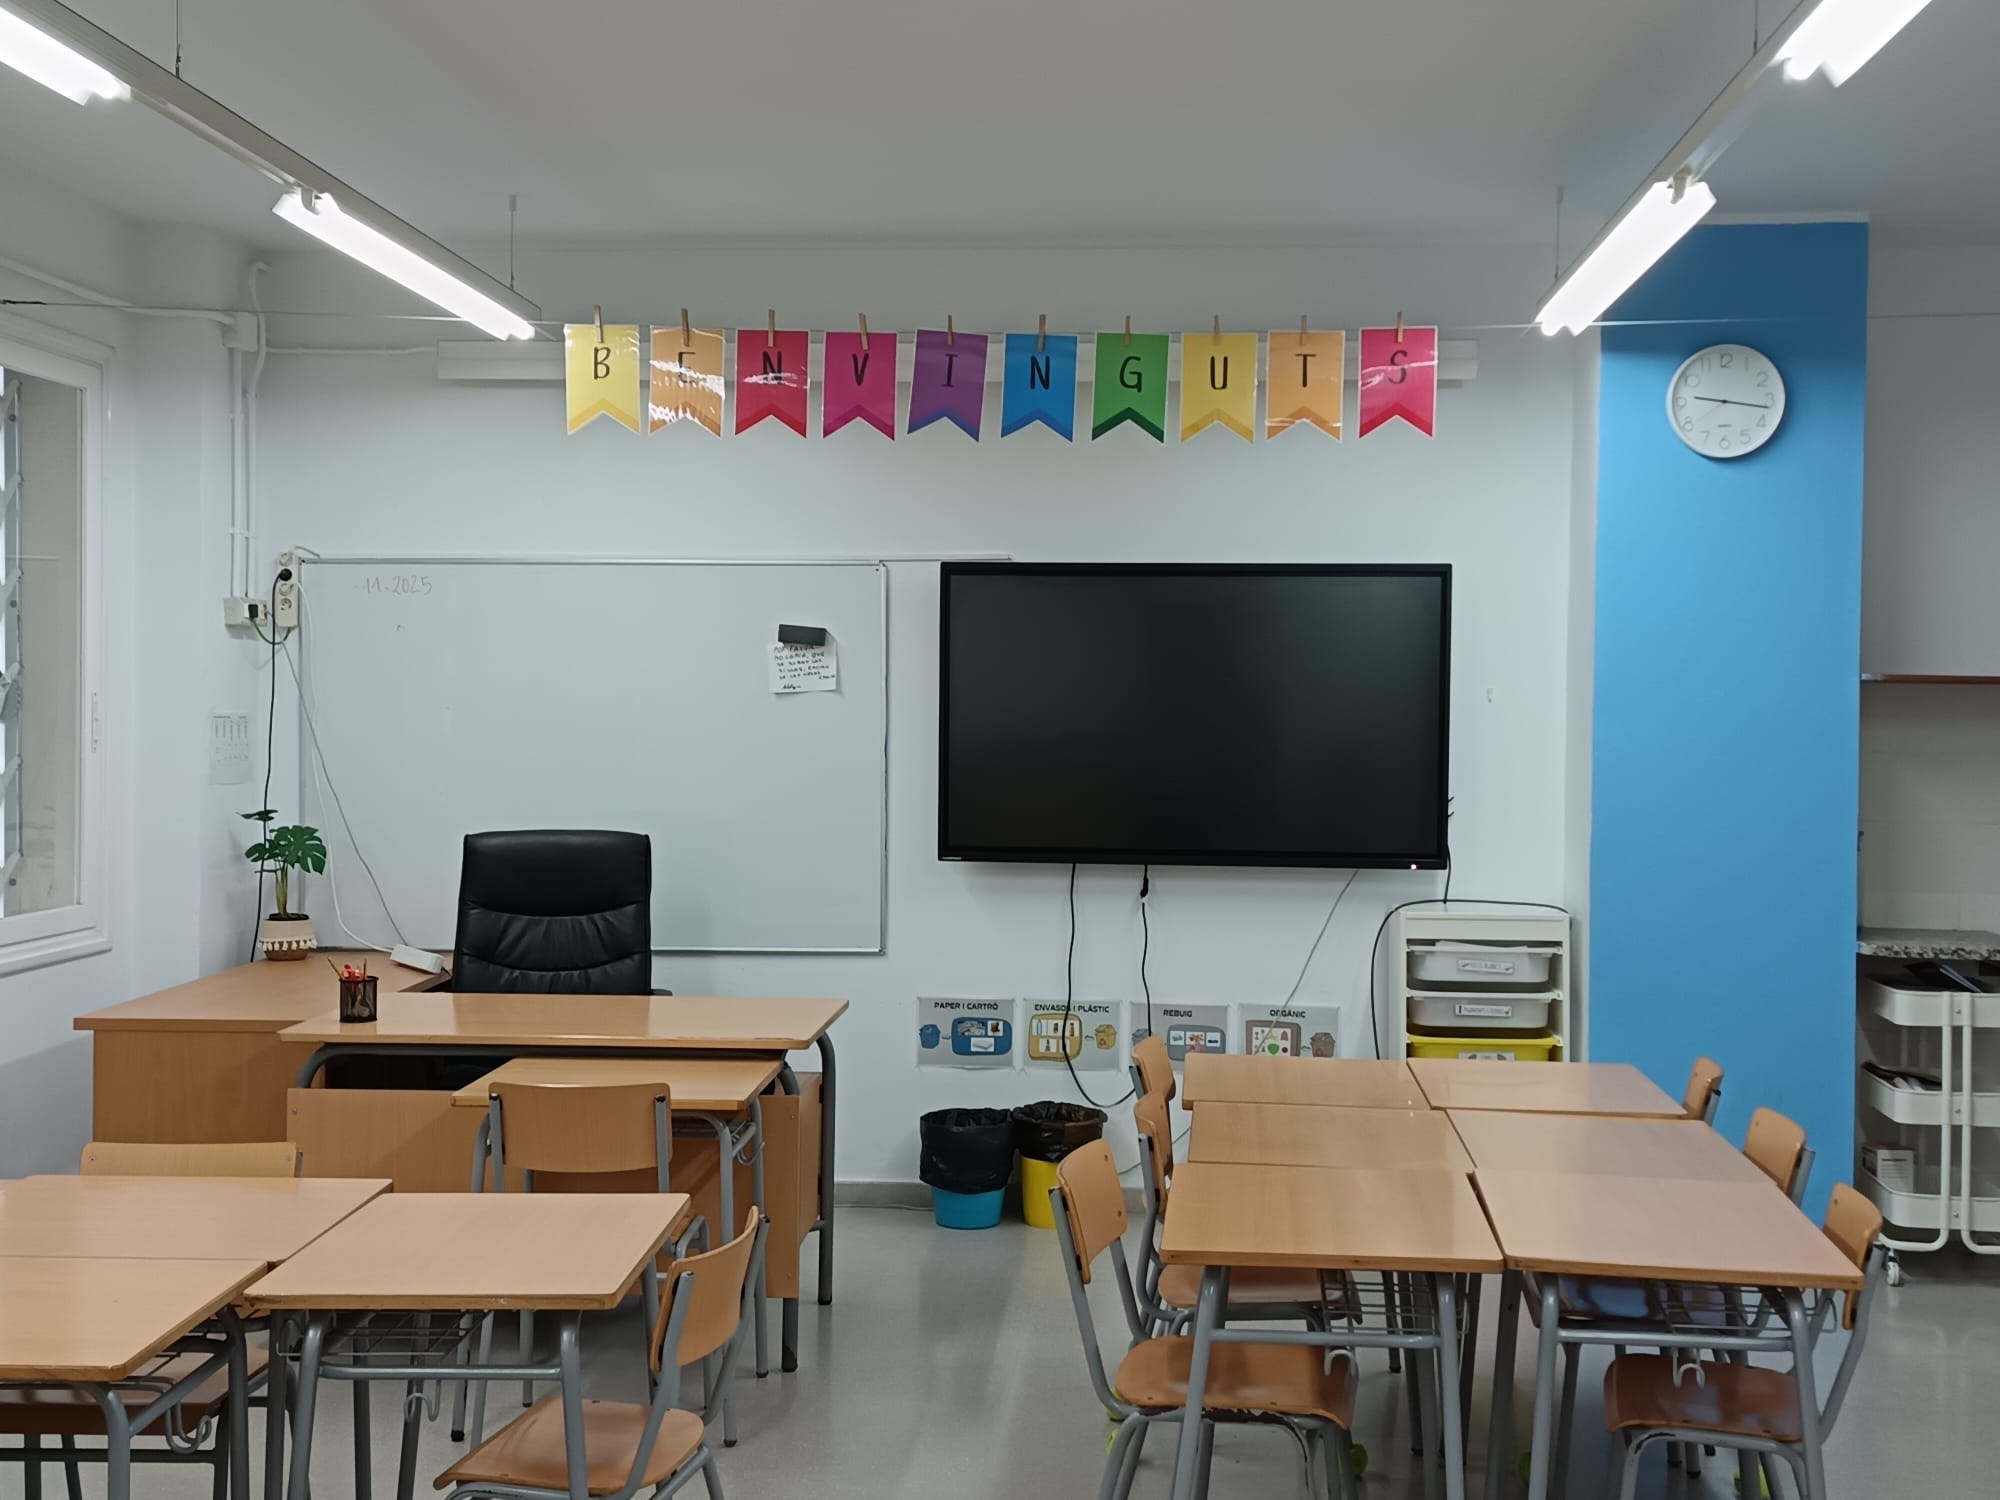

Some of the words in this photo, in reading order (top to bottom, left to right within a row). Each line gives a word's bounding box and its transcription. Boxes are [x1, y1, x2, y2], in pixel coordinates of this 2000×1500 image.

[1700, 357, 1712, 373] 11
[1720, 352, 1734, 368] 12
[1756, 371, 1769, 388] 2
[1676, 396, 1687, 409] 9
[1765, 392, 1775, 408] 3
[1683, 416, 1694, 432] 8
[1756, 414, 1767, 428] 4
[1699, 430, 1711, 445] 7
[1719, 434, 1731, 450] 6
[1740, 429, 1752, 445] 5
[934, 1002, 960, 1010] PAPER
[1163, 1009, 1193, 1018] REBUIG
